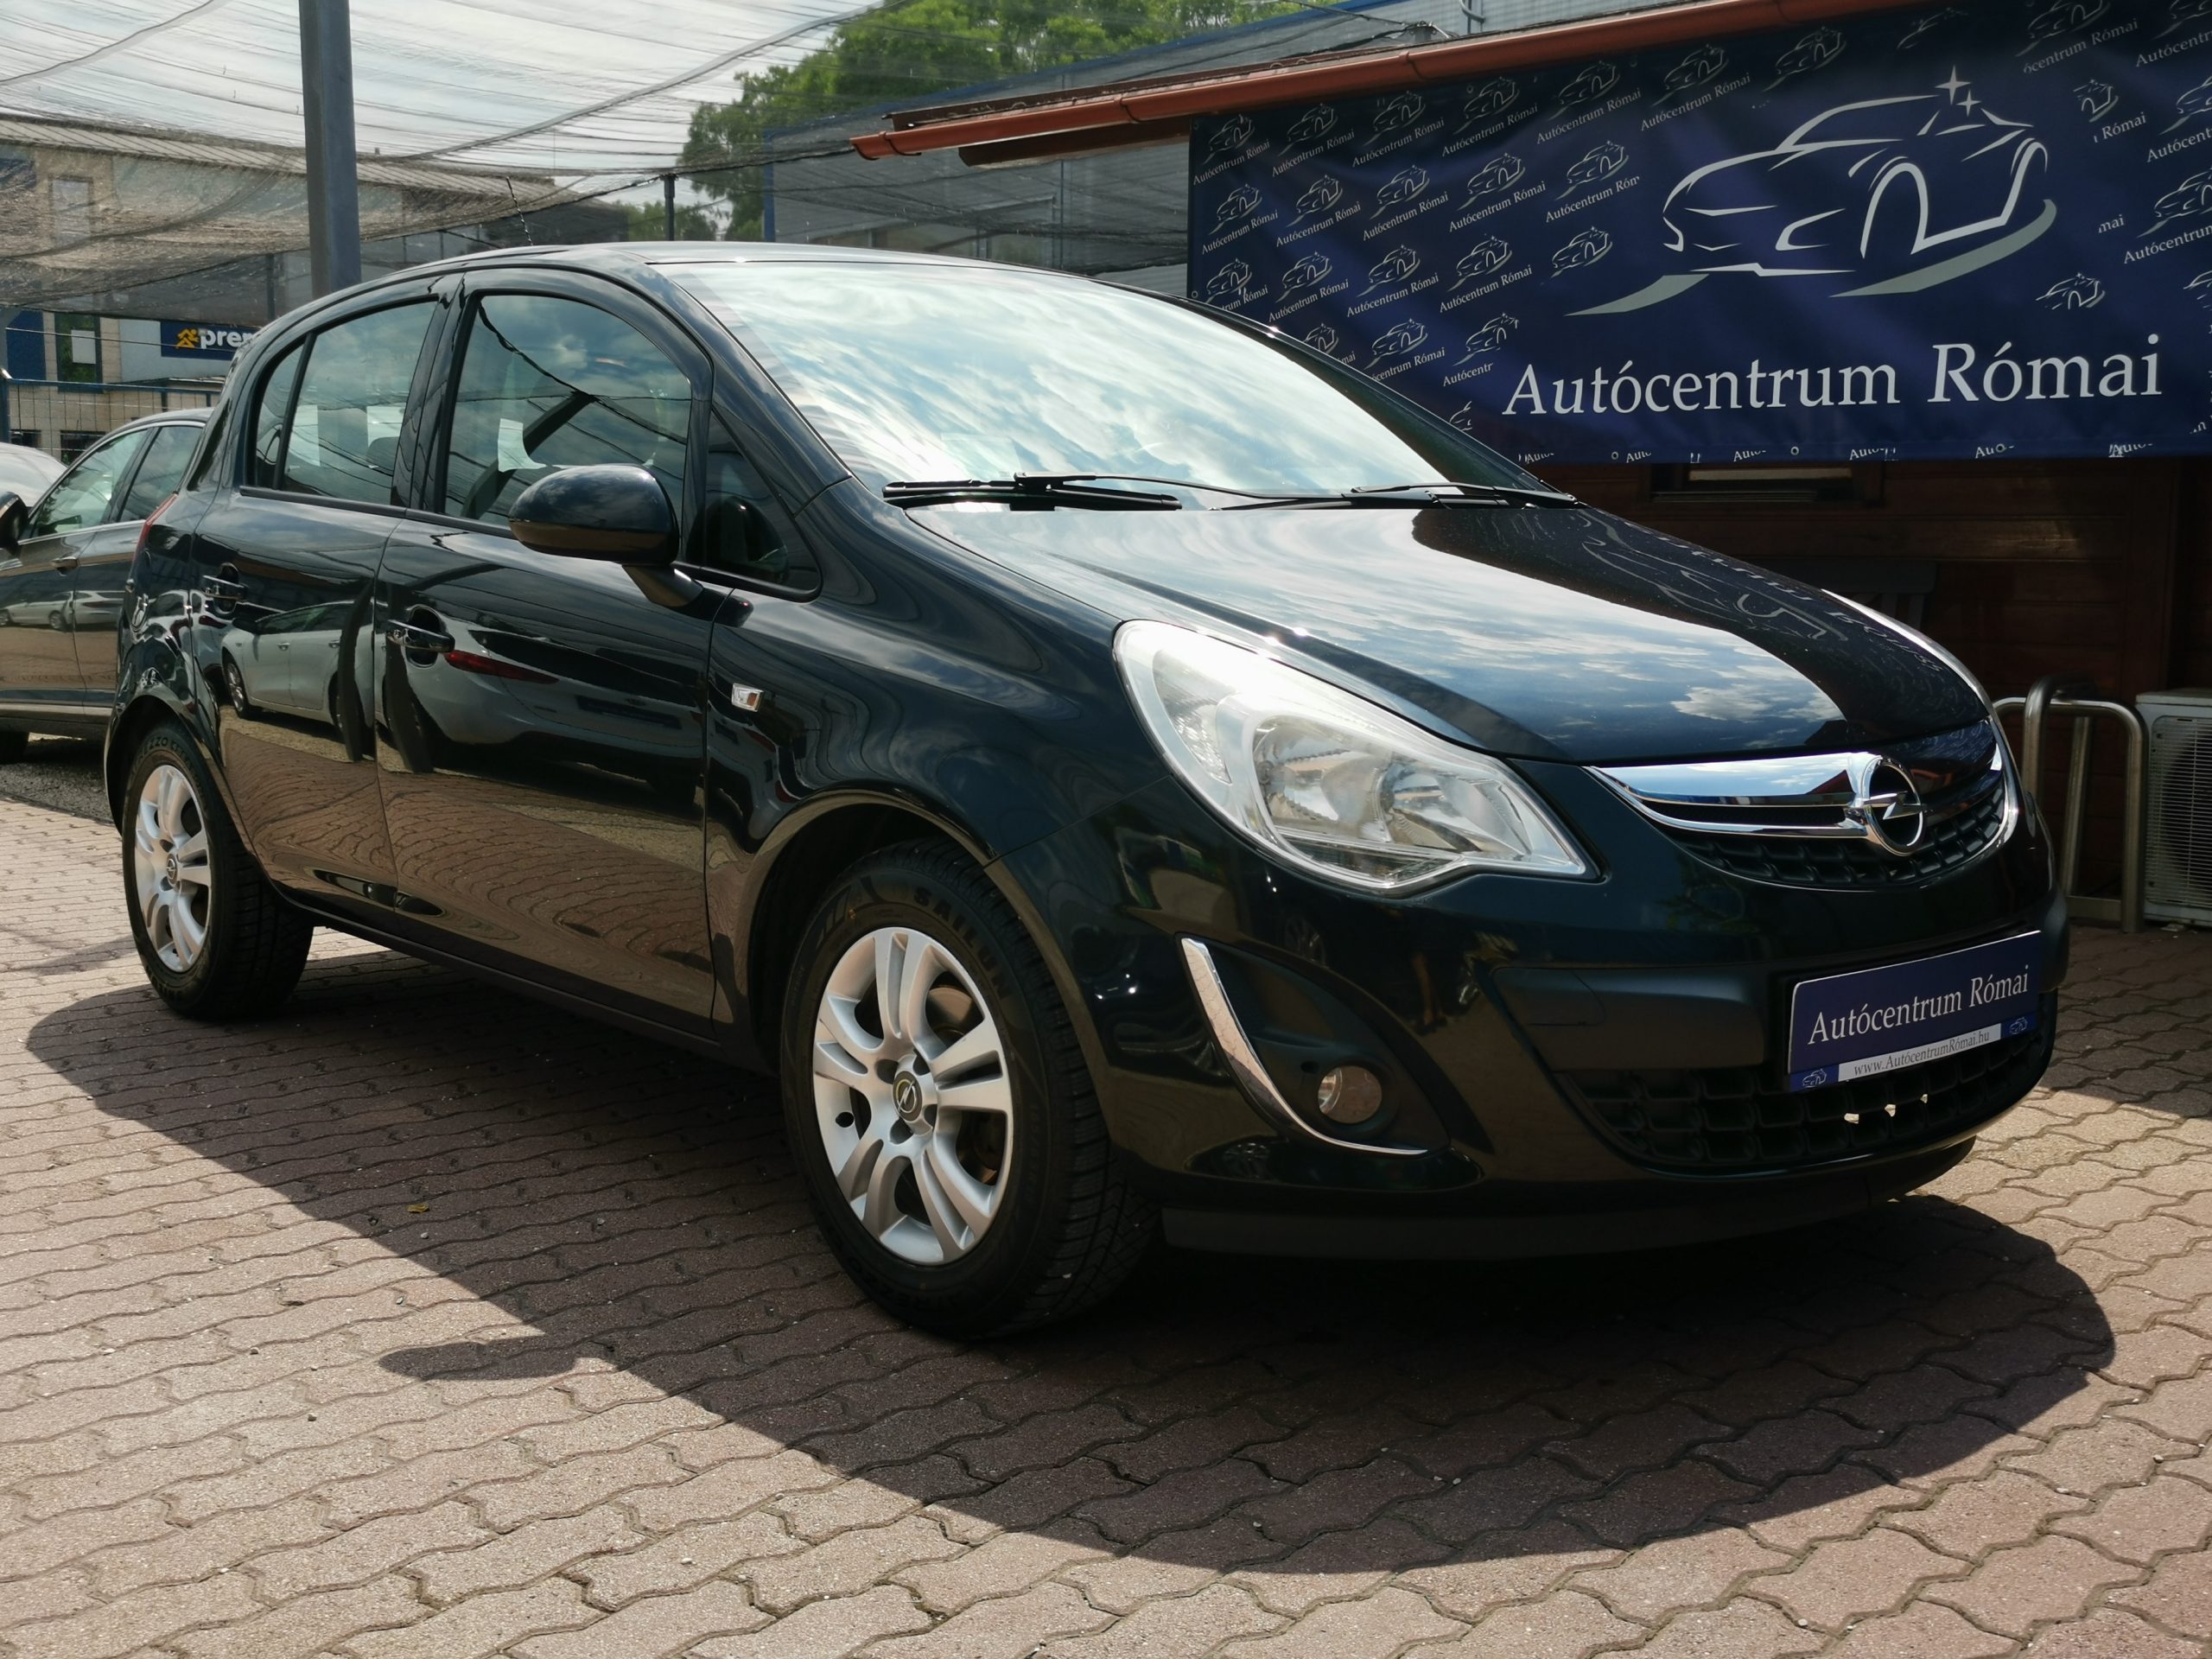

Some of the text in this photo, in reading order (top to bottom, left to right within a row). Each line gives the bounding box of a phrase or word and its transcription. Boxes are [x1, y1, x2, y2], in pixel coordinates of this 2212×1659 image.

[2091, 18, 2139, 45] Római
[1536, 87, 1642, 144] Autócentrum Római
[1642, 72, 1751, 131] Autócentrum Római
[1352, 118, 1445, 167] Autócentrum Római
[1442, 103, 1539, 156] Autócentrum Római
[2101, 111, 2147, 140] Római
[2147, 127, 2212, 162] Autócent
[1193, 138, 1270, 185] Autócentrum Római
[1272, 129, 1355, 177] Autócentrum Római
[1275, 201, 1362, 248] Autócentrum Római
[1363, 191, 1448, 241] Autócentrum Római
[1449, 181, 1547, 232] Autócentrum Római
[1546, 188, 1613, 223] Autócentrum
[1202, 209, 1279, 255] Autócentrum Római
[1268, 279, 1350, 323] Autócentrum Római
[1347, 272, 1440, 318] Autócentrum Római
[1440, 264, 1533, 314] Autócentrum Római
[1414, 347, 1446, 367] Római
[1503, 334, 2163, 416] Autócentrum Római
[1808, 964, 2029, 1045] Autócentrum Római
[1853, 1030, 1991, 1077] www.AutócentrumRómai.hu
